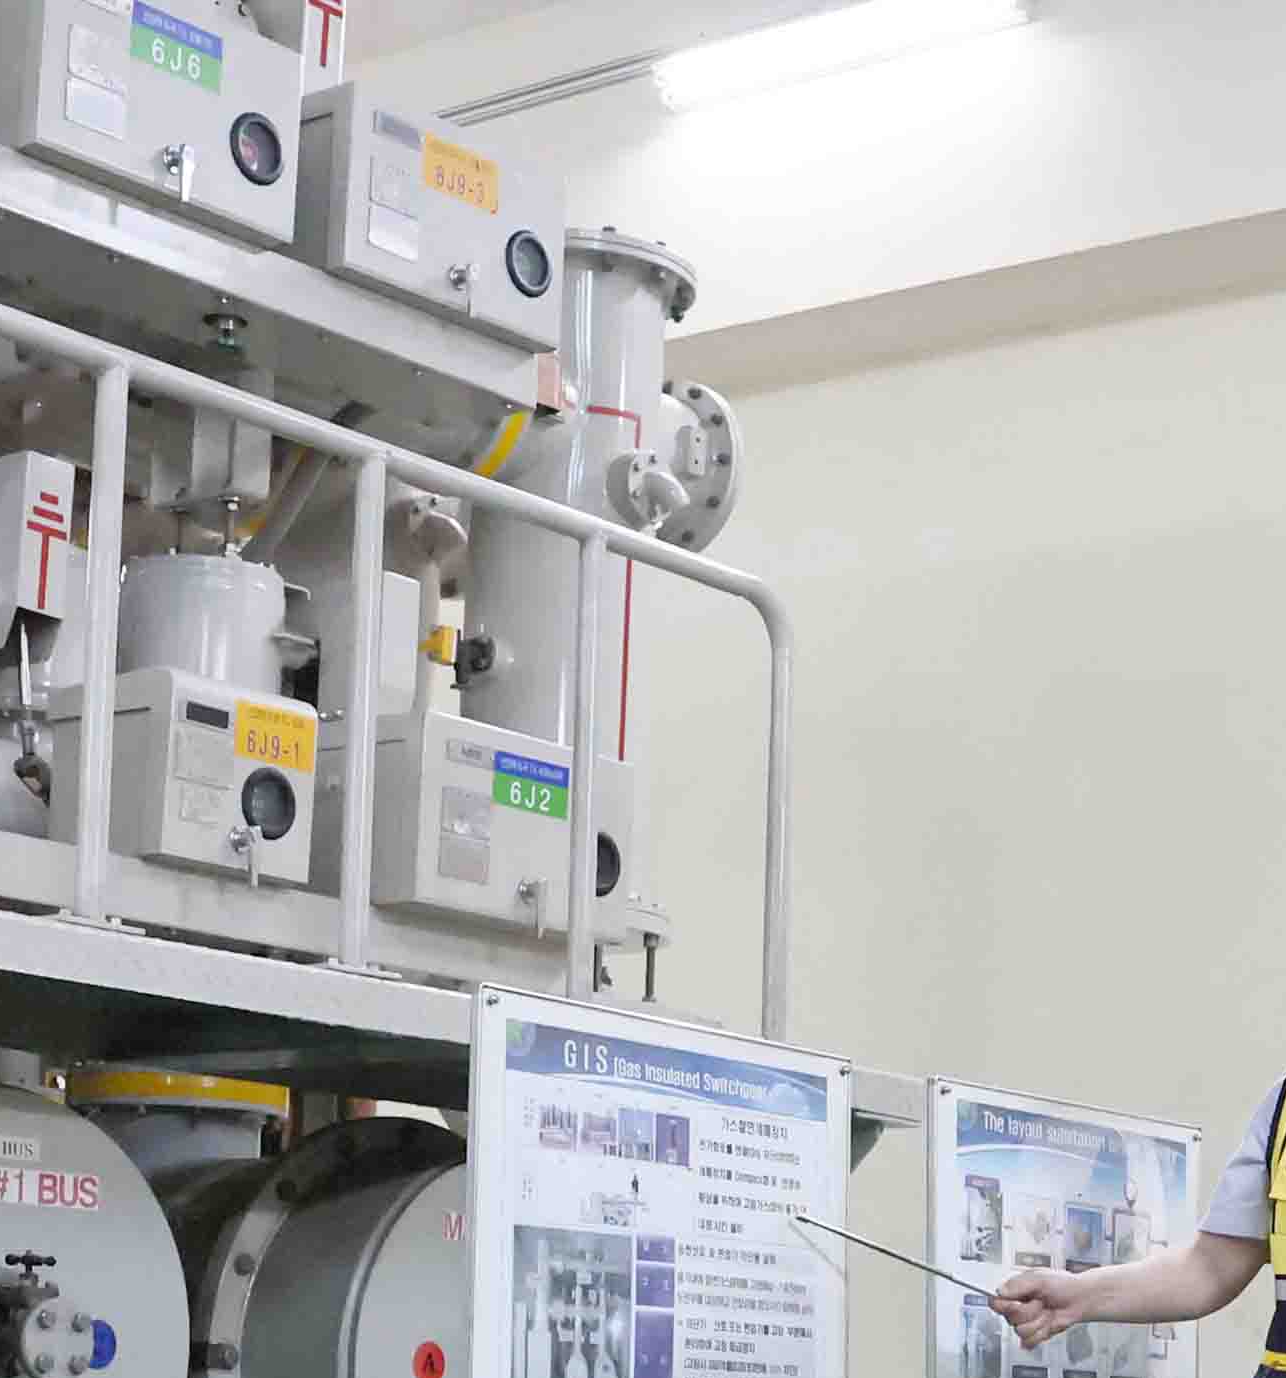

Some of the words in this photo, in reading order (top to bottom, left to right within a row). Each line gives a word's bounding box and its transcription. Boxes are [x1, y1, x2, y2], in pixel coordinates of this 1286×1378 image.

[151, 37, 202, 81] 6J6
[247, 729, 299, 769] 6J9-1
[509, 780, 552, 812] 6J2
[644, 1062, 701, 1089] Insulated
[983, 1110, 1004, 1134] The
[38, 1172, 99, 1209] BUS
[422, 1352, 437, 1376] A
